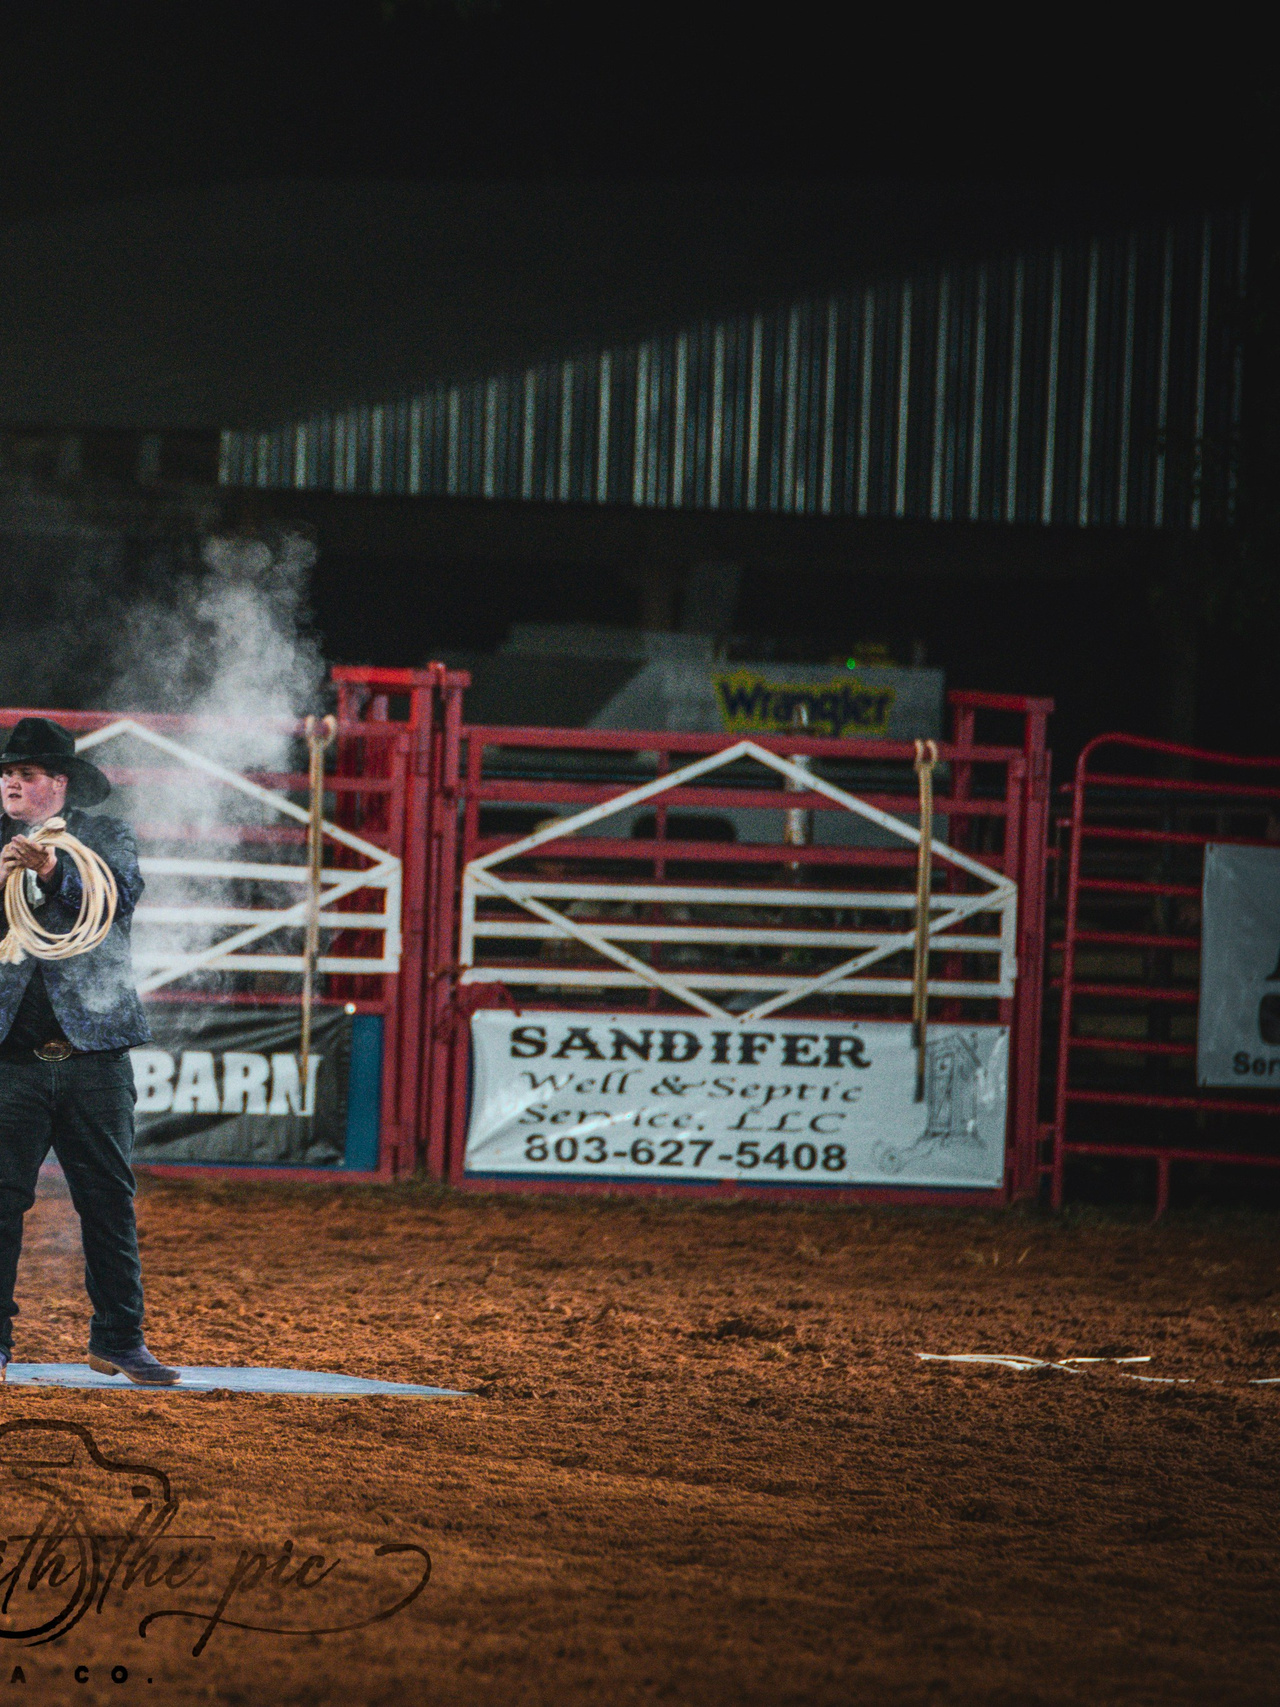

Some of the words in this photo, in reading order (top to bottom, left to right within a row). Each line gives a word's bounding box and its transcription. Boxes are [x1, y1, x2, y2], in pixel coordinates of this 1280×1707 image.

[720, 680, 892, 738] Wrangler
[509, 1025, 872, 1069] SANDIFER
[129, 1048, 324, 1117] BARN
[519, 1068, 642, 1096] Well
[707, 1076, 863, 1108] Septic
[727, 1106, 848, 1135] LLC
[523, 1134, 848, 1173] 803-627-5408
